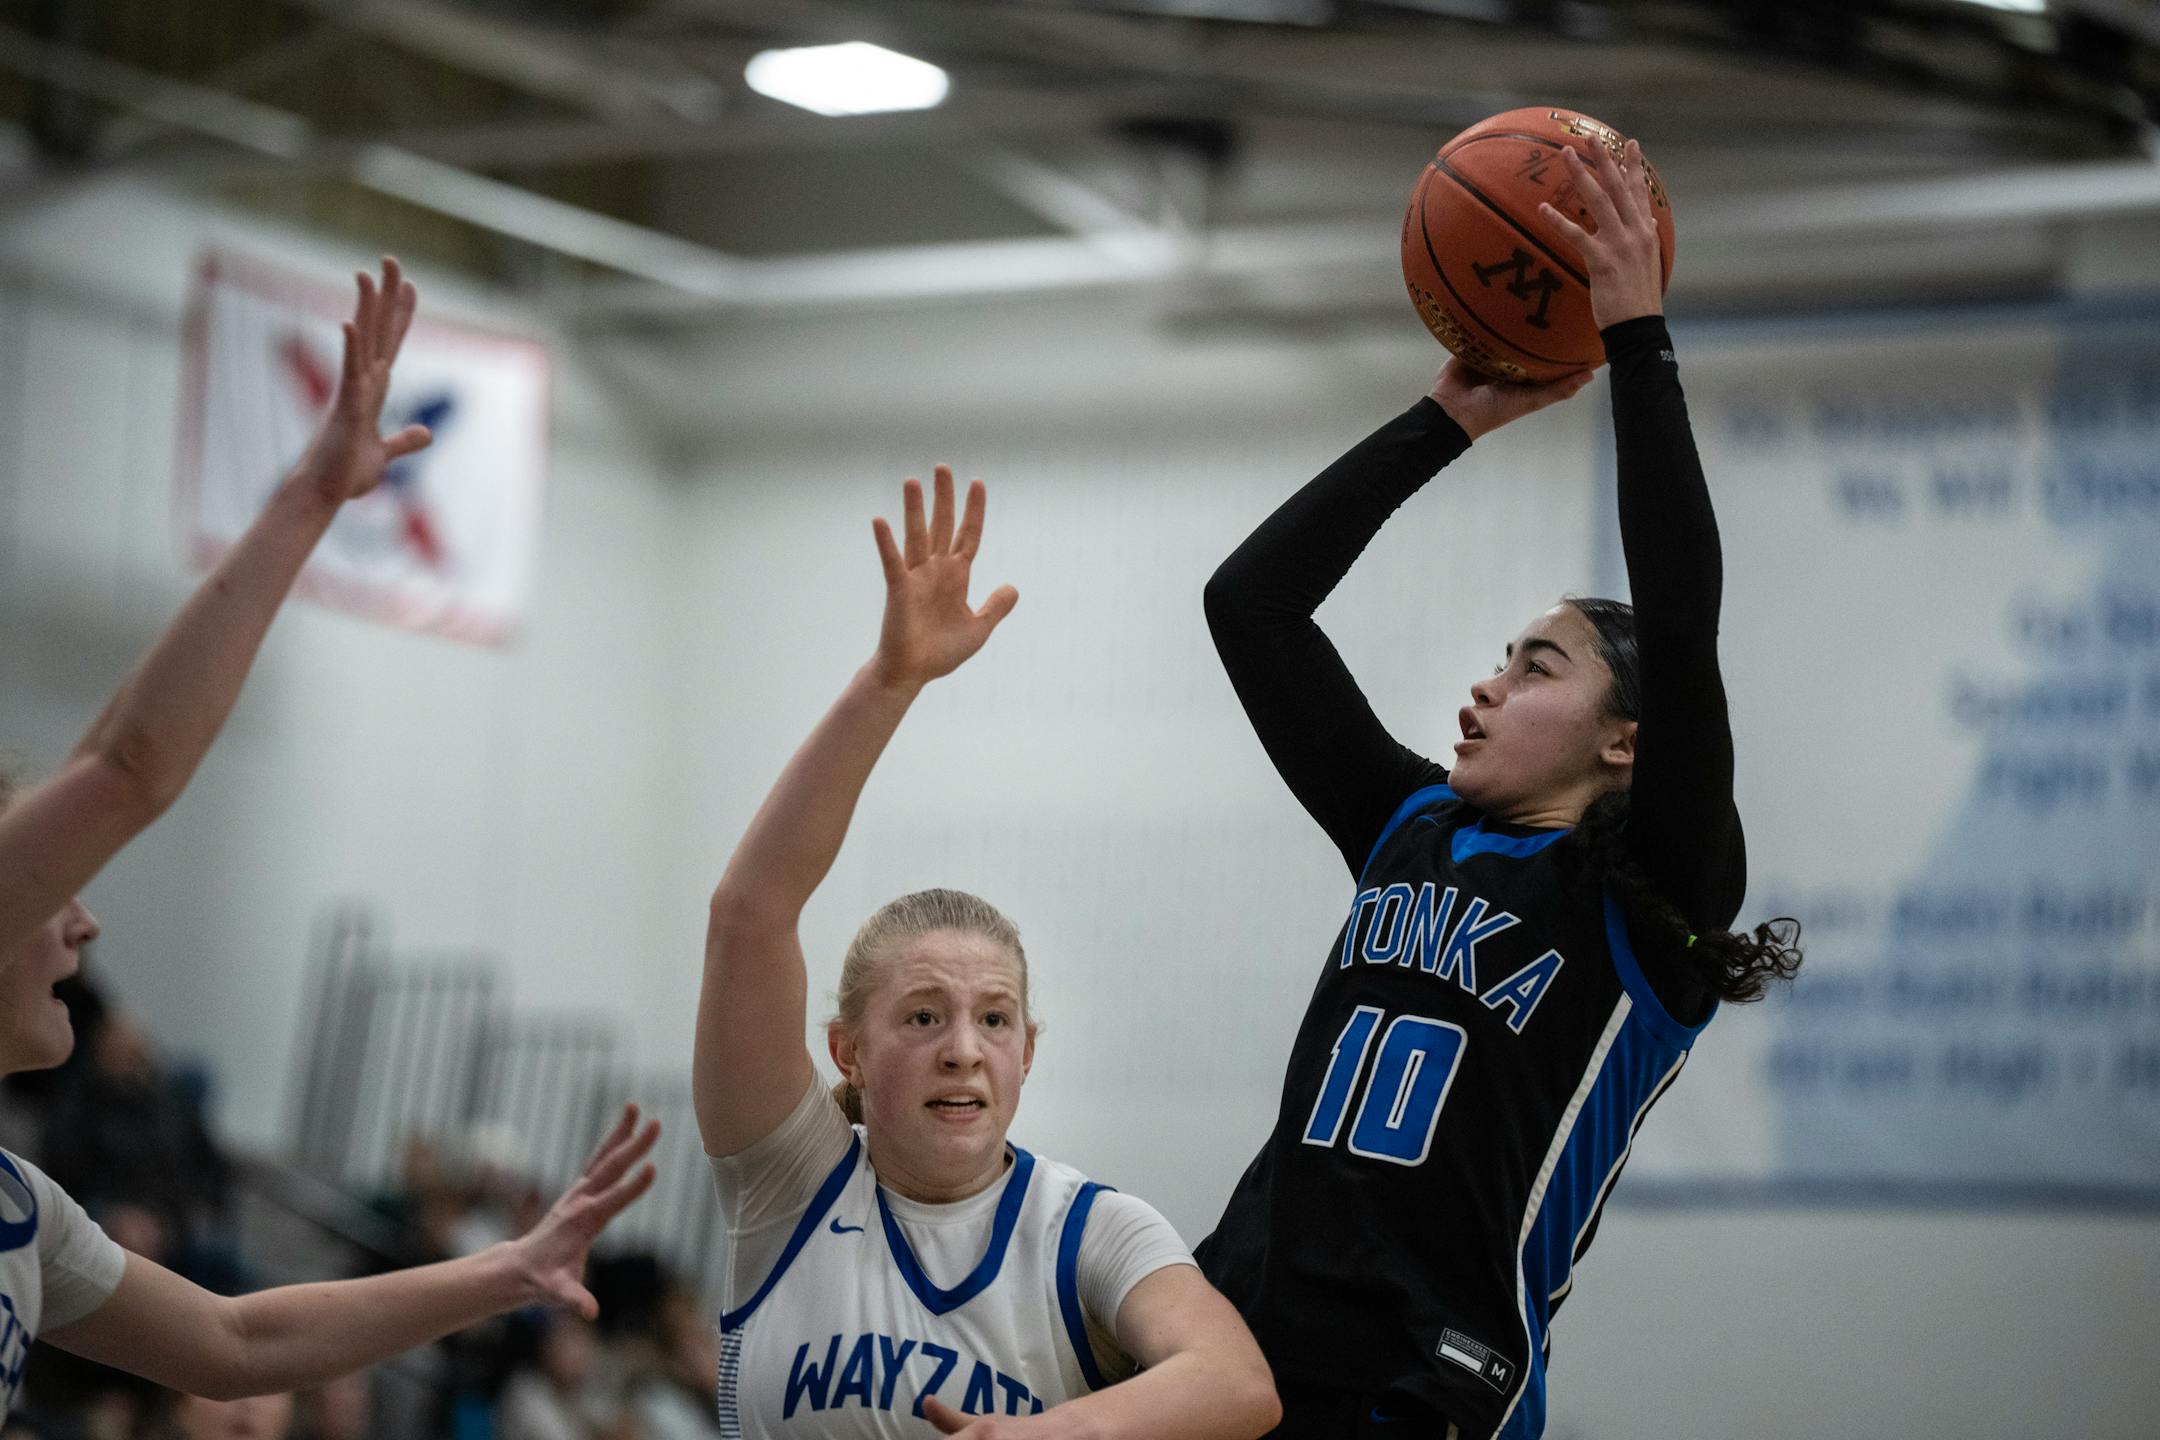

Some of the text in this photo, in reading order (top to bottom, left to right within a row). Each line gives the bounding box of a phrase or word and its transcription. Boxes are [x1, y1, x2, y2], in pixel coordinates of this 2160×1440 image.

[1471, 247, 1564, 330] M
[1340, 881, 1565, 1035] TONKA
[1302, 1005, 1468, 1168] 10
[783, 1332, 1043, 1420] WAYZAT
[1490, 1362, 1507, 1382] M
